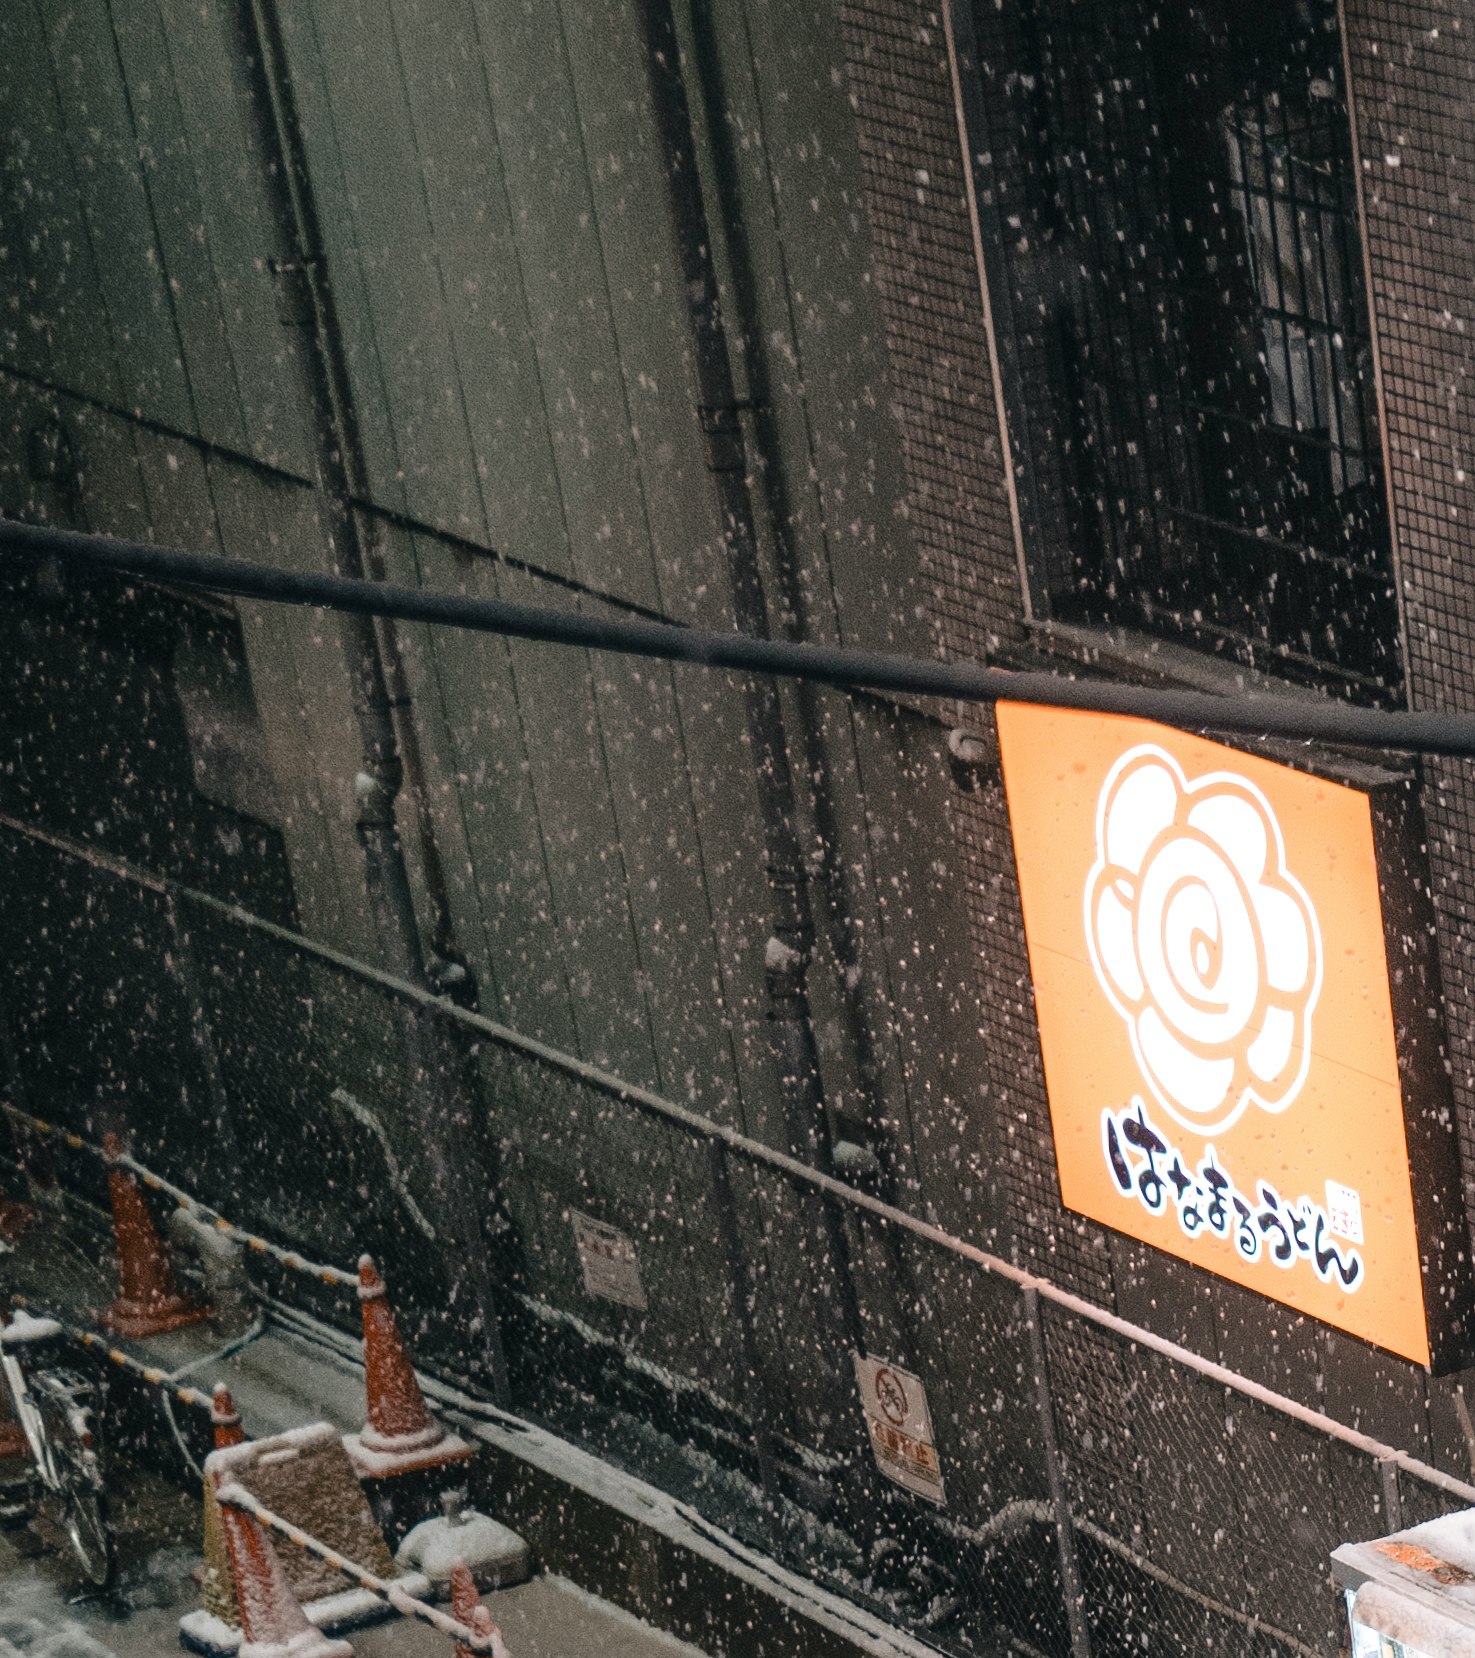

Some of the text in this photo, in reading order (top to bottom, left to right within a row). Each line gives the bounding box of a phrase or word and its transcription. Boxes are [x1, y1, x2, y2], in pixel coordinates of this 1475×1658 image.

[1105, 1103, 1359, 1287] はなまるうどん
